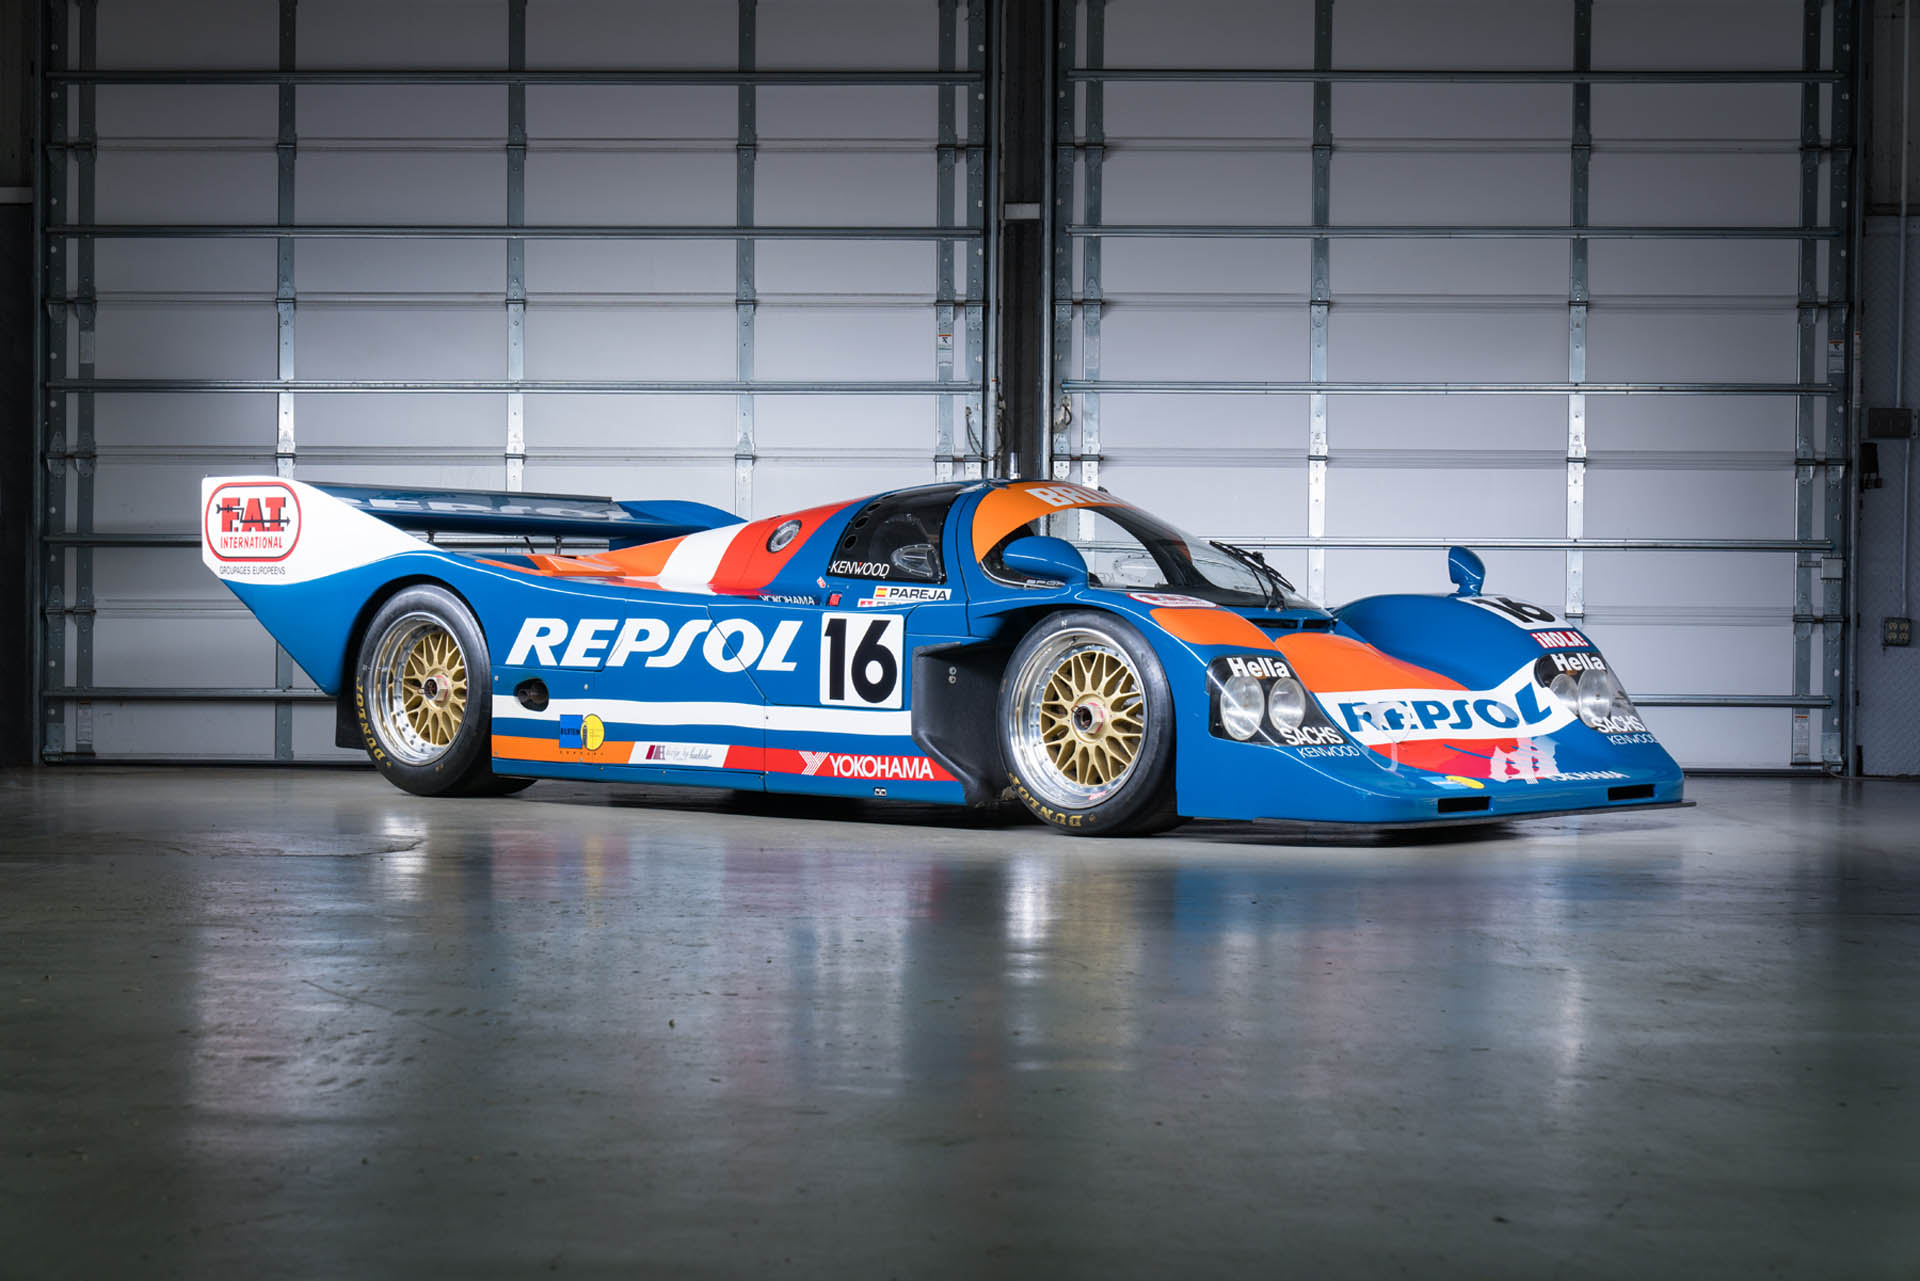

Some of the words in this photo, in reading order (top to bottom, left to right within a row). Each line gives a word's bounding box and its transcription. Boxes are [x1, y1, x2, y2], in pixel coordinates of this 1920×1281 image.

[220, 536, 283, 549] INTERNATIONAL
[219, 566, 251, 575] GROUPAGES
[252, 566, 286, 575] EUROPEENS
[830, 561, 890, 577] KENWOOD
[889, 588, 947, 600] PAREJA
[1471, 597, 1556, 623] 16
[505, 617, 803, 673] REPSOL
[824, 619, 898, 704] 16
[1226, 657, 1291, 678] Hella
[1551, 654, 1606, 672] Hella
[1338, 682, 1553, 733] REPSOL
[356, 676, 386, 761] DUNLOP
[1592, 716, 1647, 733] SACHS
[1279, 727, 1344, 746] SACHS
[1297, 746, 1360, 758] KENWOOD
[829, 754, 934, 780] YOKOHAMA
